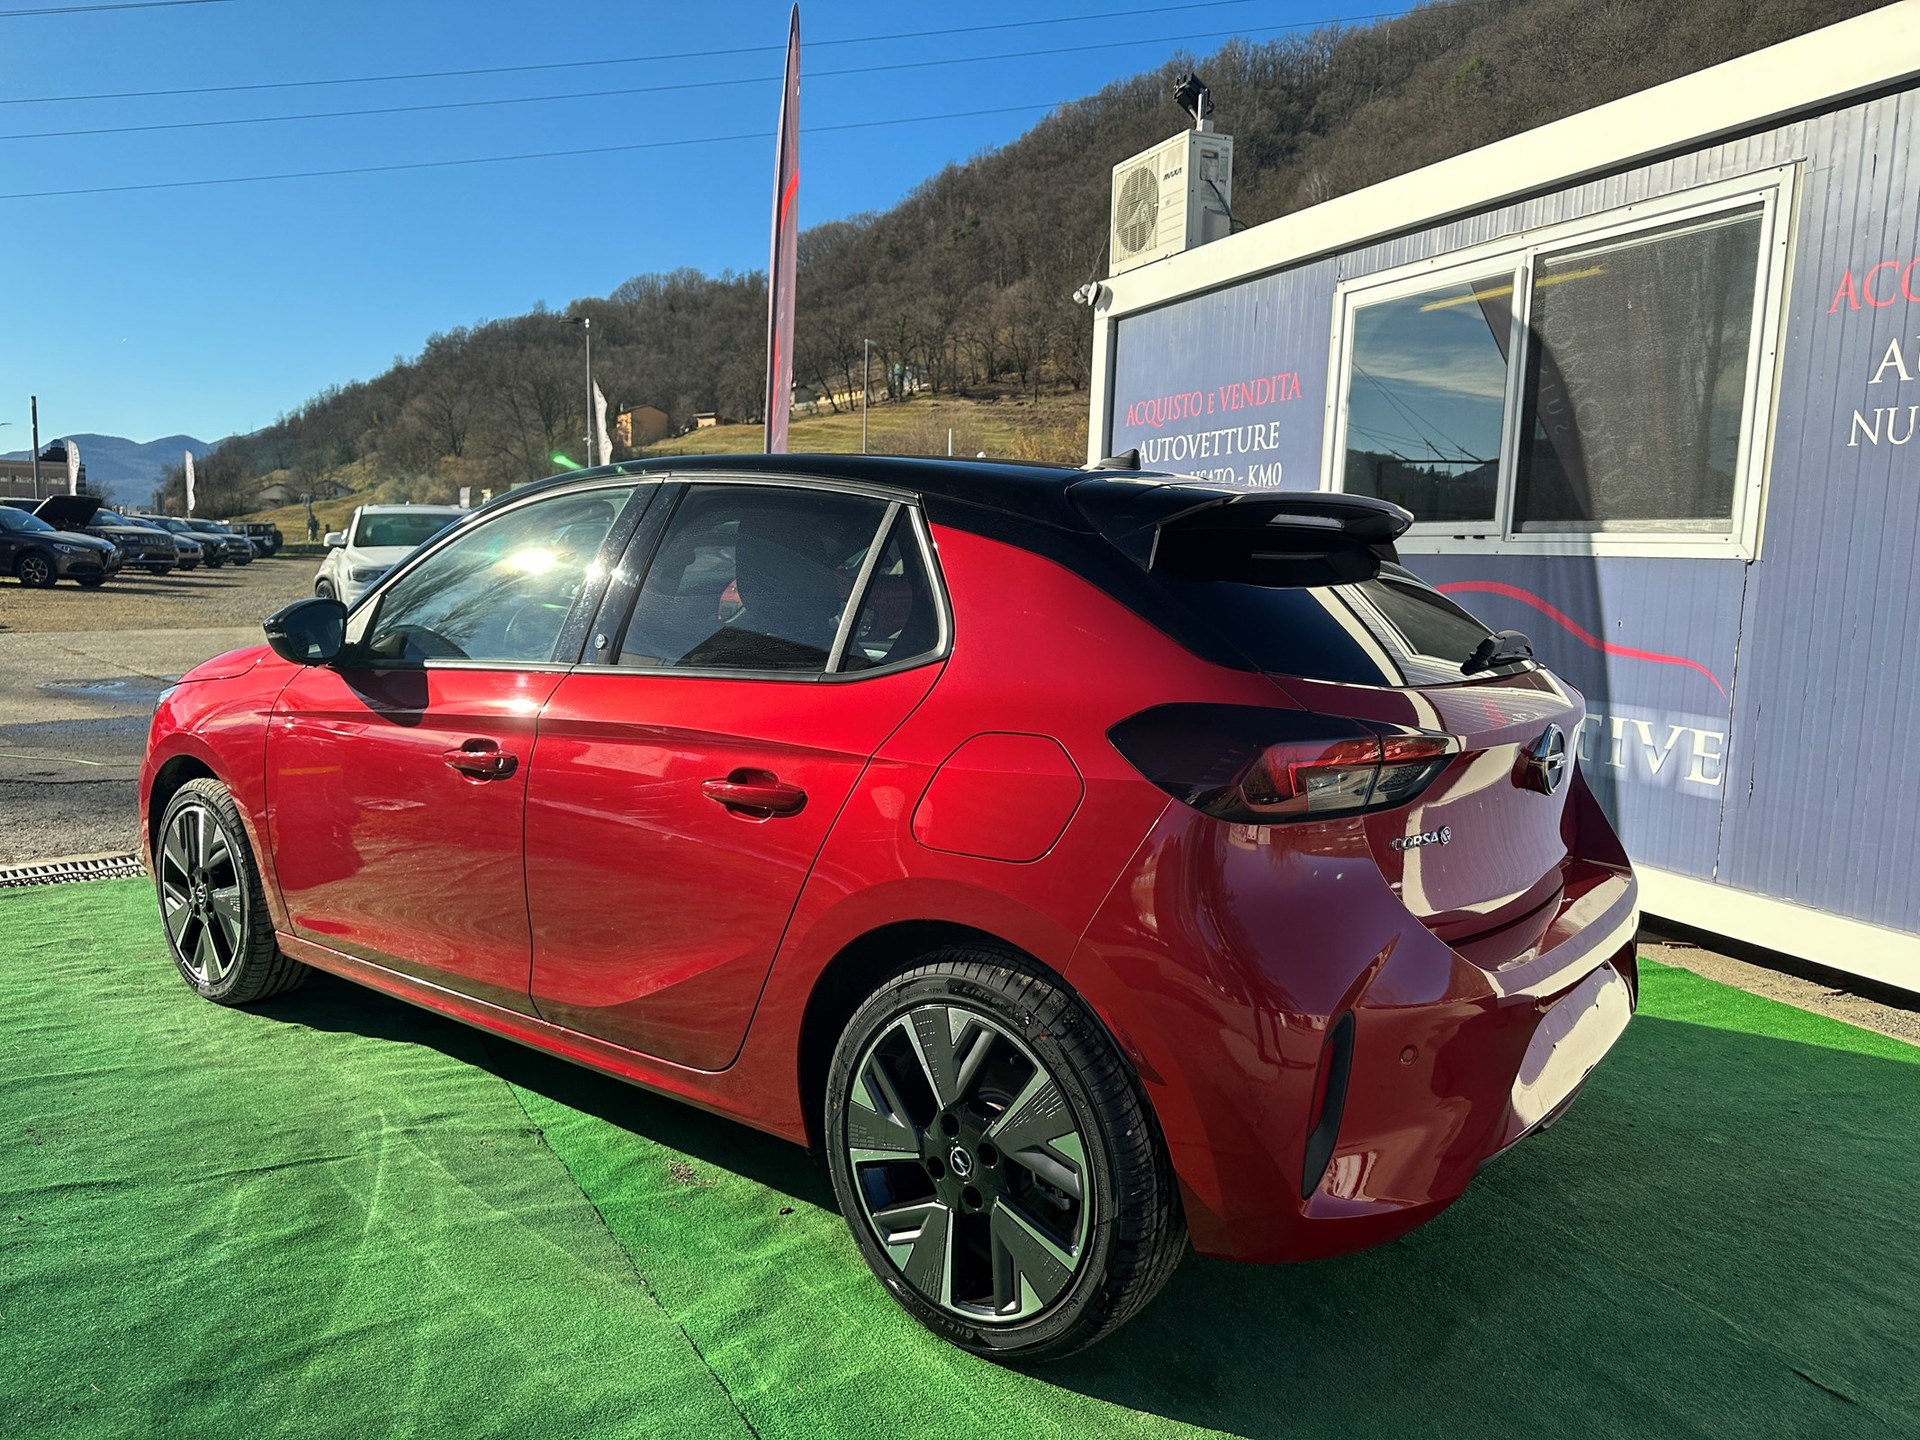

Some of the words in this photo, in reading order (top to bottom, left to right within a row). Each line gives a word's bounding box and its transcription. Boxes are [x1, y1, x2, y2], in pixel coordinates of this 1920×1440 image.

[1868, 336, 1920, 384] A
[1125, 391, 1203, 428] ACQUISTO
[1218, 371, 1302, 413] VENDITA
[1139, 421, 1281, 464] AUTOVETTURE
[1389, 831, 1438, 851] CORSA
